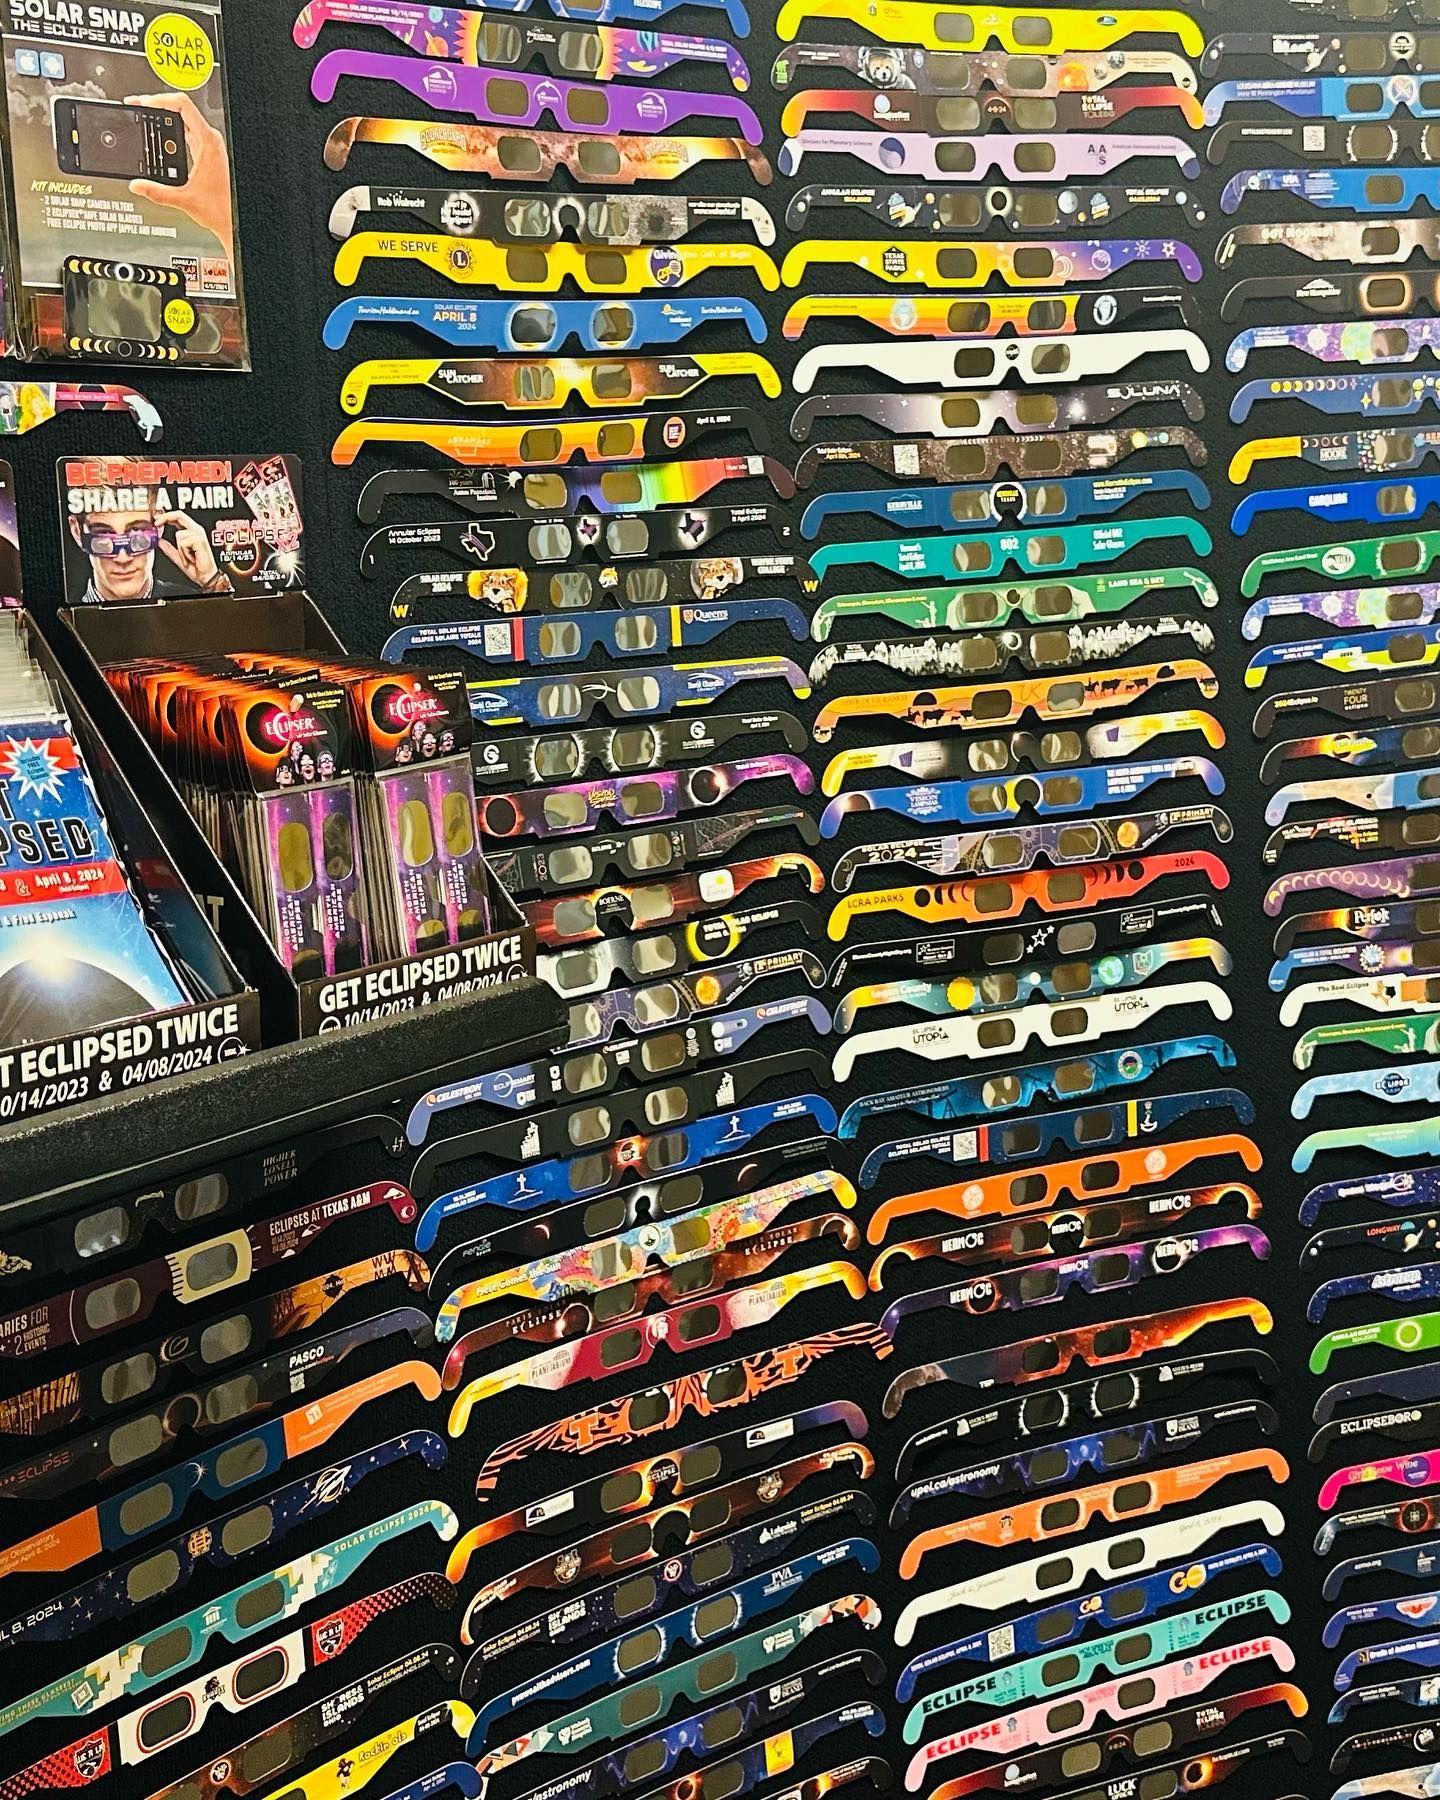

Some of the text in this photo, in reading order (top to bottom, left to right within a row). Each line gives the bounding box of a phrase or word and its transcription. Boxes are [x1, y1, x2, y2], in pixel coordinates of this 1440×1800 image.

[90, 8, 144, 33] SNAP
[11, 17, 139, 46] THE ECLIPSE APP
[153, 32, 203, 51] SOLAR
[155, 48, 206, 70] SNAP
[32, 180, 93, 195] KIT INCLUDES
[378, 240, 439, 252] WE SERVE
[457, 252, 466, 266] L
[167, 315, 192, 325] SNAP
[433, 312, 477, 322] APRIL 8
[438, 369, 456, 378] SUN
[447, 375, 484, 384] CATCHER
[66, 461, 232, 486] BE PREPARED!
[68, 486, 234, 514] SHARE A PAIR!
[212, 528, 286, 546] ECLIPSE
[782, 527, 790, 536] 2
[420, 573, 463, 584] SOLAR ECLIPSE
[757, 565, 785, 574] COLLEGE
[432, 582, 452, 592] 2024
[803, 580, 818, 592] W
[393, 604, 409, 618] W
[1343, 687, 1367, 696] TWENTY
[1343, 694, 1368, 704] FOUR
[1344, 702, 1368, 711] eclipse
[1181, 808, 1214, 819] PRIMARY
[861, 840, 924, 853] SOLAR ECLIPSE
[868, 848, 917, 863] 2024
[1175, 858, 1195, 868] 2024
[36, 871, 62, 888] April
[77, 868, 104, 882] 2024
[336, 888, 345, 931] ECLIPSE
[599, 896, 625, 906] BOERNE
[847, 894, 905, 909] LCRA PARKS
[325, 894, 334, 930] NORTH
[293, 900, 304, 944] ECLIPSE
[319, 936, 522, 1013] GET ECLIPSED TWICE
[766, 1000, 808, 1016] CELESTRON
[21, 1025, 152, 1084] ECLIPSED
[157, 1004, 238, 1049] TWICE
[913, 1028, 949, 1044] UTOPIA
[98, 1046, 213, 1091] & 04/08/2024
[435, 1083, 483, 1103] CELESTRON
[912, 1085, 950, 1097] ASTRONOMERS
[263, 1150, 296, 1168] HIGHER
[264, 1160, 296, 1176] LONELY
[264, 1167, 298, 1186] POWER
[269, 1191, 371, 1236] ECLIPSES AT TEXAS A&M
[1367, 1224, 1400, 1236] LONGWAY
[744, 1236, 794, 1256] ECLIPSE
[475, 1268, 546, 1298] Here Comes the
[1371, 1270, 1422, 1289] Astrozap
[749, 1288, 787, 1306] PLANETARIUM
[31, 1306, 49, 1325] FOR
[512, 1309, 563, 1335] ECLIPSE
[23, 1323, 50, 1341] HISTORIC
[14, 1335, 23, 1355] 2
[24, 1336, 46, 1352] EVENTS
[289, 1345, 325, 1369] PASCO
[775, 1345, 803, 1379] T
[531, 1356, 571, 1378] PLANETARIUM
[569, 1412, 600, 1449] T
[18, 1451, 73, 1483] ECLIPSE
[911, 1464, 1000, 1498] upei.ca/astronomy
[334, 1506, 430, 1554] SOLAR ECLIPSE 2024
[771, 1567, 793, 1584] PVA
[11, 1602, 64, 1634] 8, 2024
[549, 1608, 586, 1630] ISLANDS
[1195, 1595, 1267, 1625] ECLIPSE
[1199, 1640, 1272, 1669] ECLIPSE
[367, 1651, 429, 1688] Solar Eclipse 04.08.24
[922, 1676, 997, 1714] ECLIPSE
[322, 1694, 365, 1721] ISLANDS
[1196, 1707, 1219, 1717] TOTAL
[323, 1713, 342, 1727] OHIO
[926, 1723, 1001, 1758] ECLIPSE
[1108, 1778, 1138, 1796] LUCK
